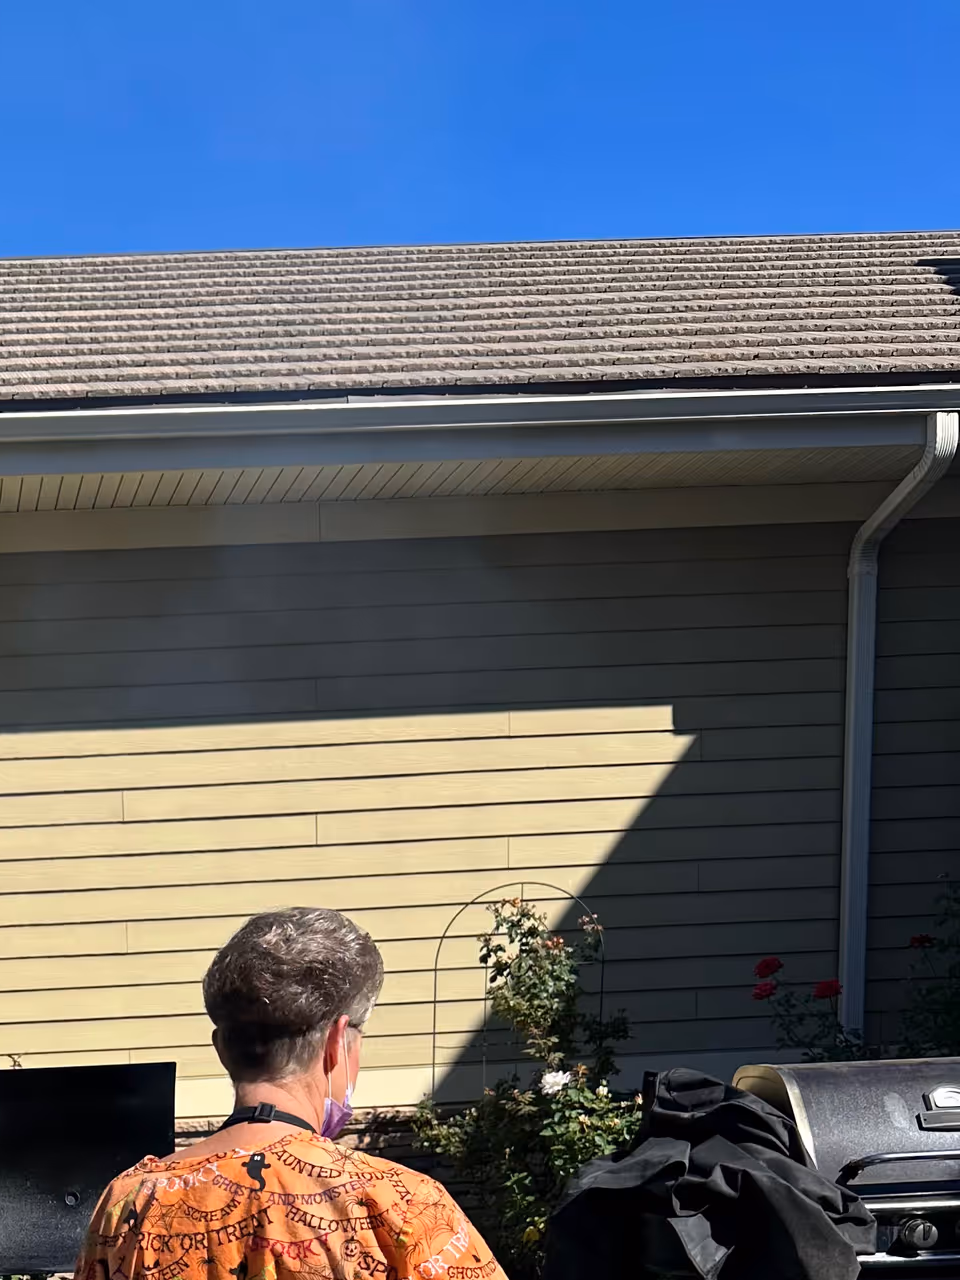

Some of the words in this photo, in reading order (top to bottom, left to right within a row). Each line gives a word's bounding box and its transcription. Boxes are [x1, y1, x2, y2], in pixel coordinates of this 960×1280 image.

[212, 1174, 261, 1200] GHOSTS
[266, 1192, 296, 1206] AND
[184, 1197, 242, 1223] SCREAM
[285, 1205, 387, 1233] HALLOWEEN
[180, 1231, 208, 1251] OR
[213, 1206, 274, 1247] TREAT
